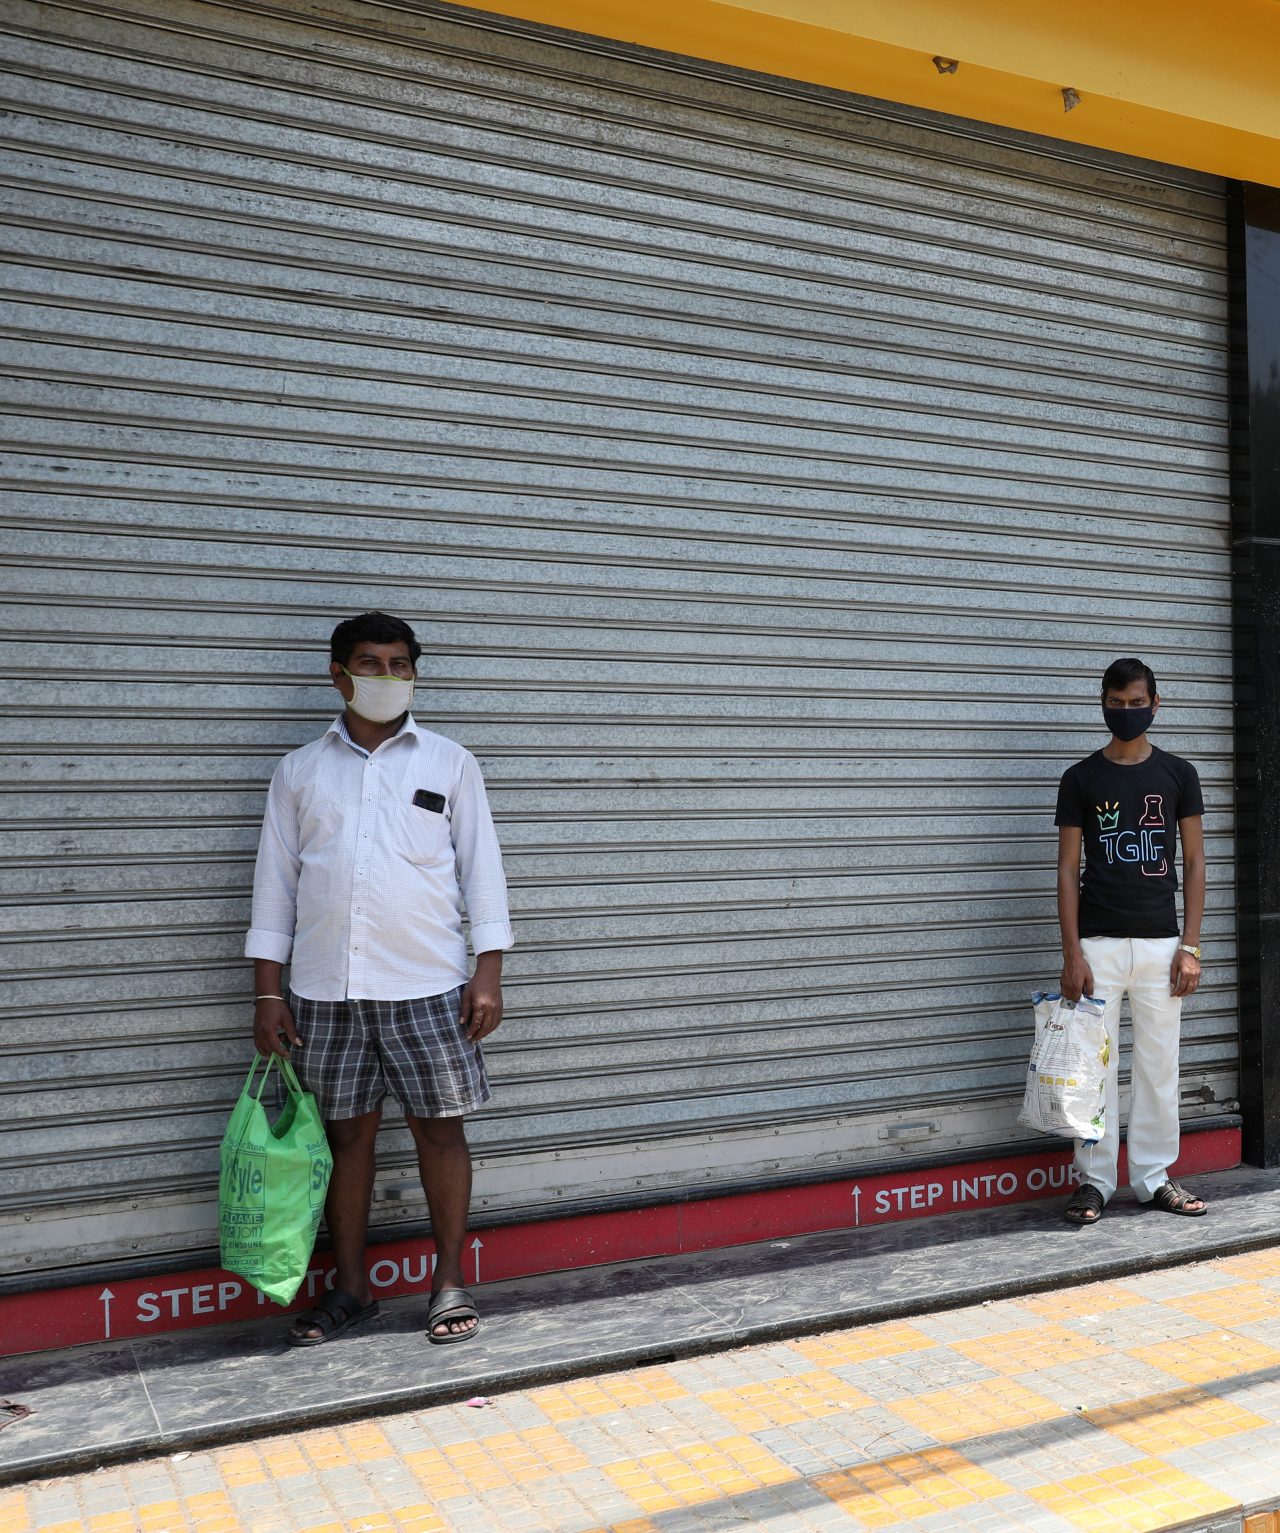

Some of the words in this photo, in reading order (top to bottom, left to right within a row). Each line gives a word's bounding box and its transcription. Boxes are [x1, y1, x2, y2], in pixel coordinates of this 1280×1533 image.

[1099, 830, 1165, 864] TGIF
[875, 1182, 944, 1214] STEP
[952, 1172, 1018, 1203] INTO
[1026, 1163, 1081, 1191] OUR
[136, 1281, 242, 1322] STEP
